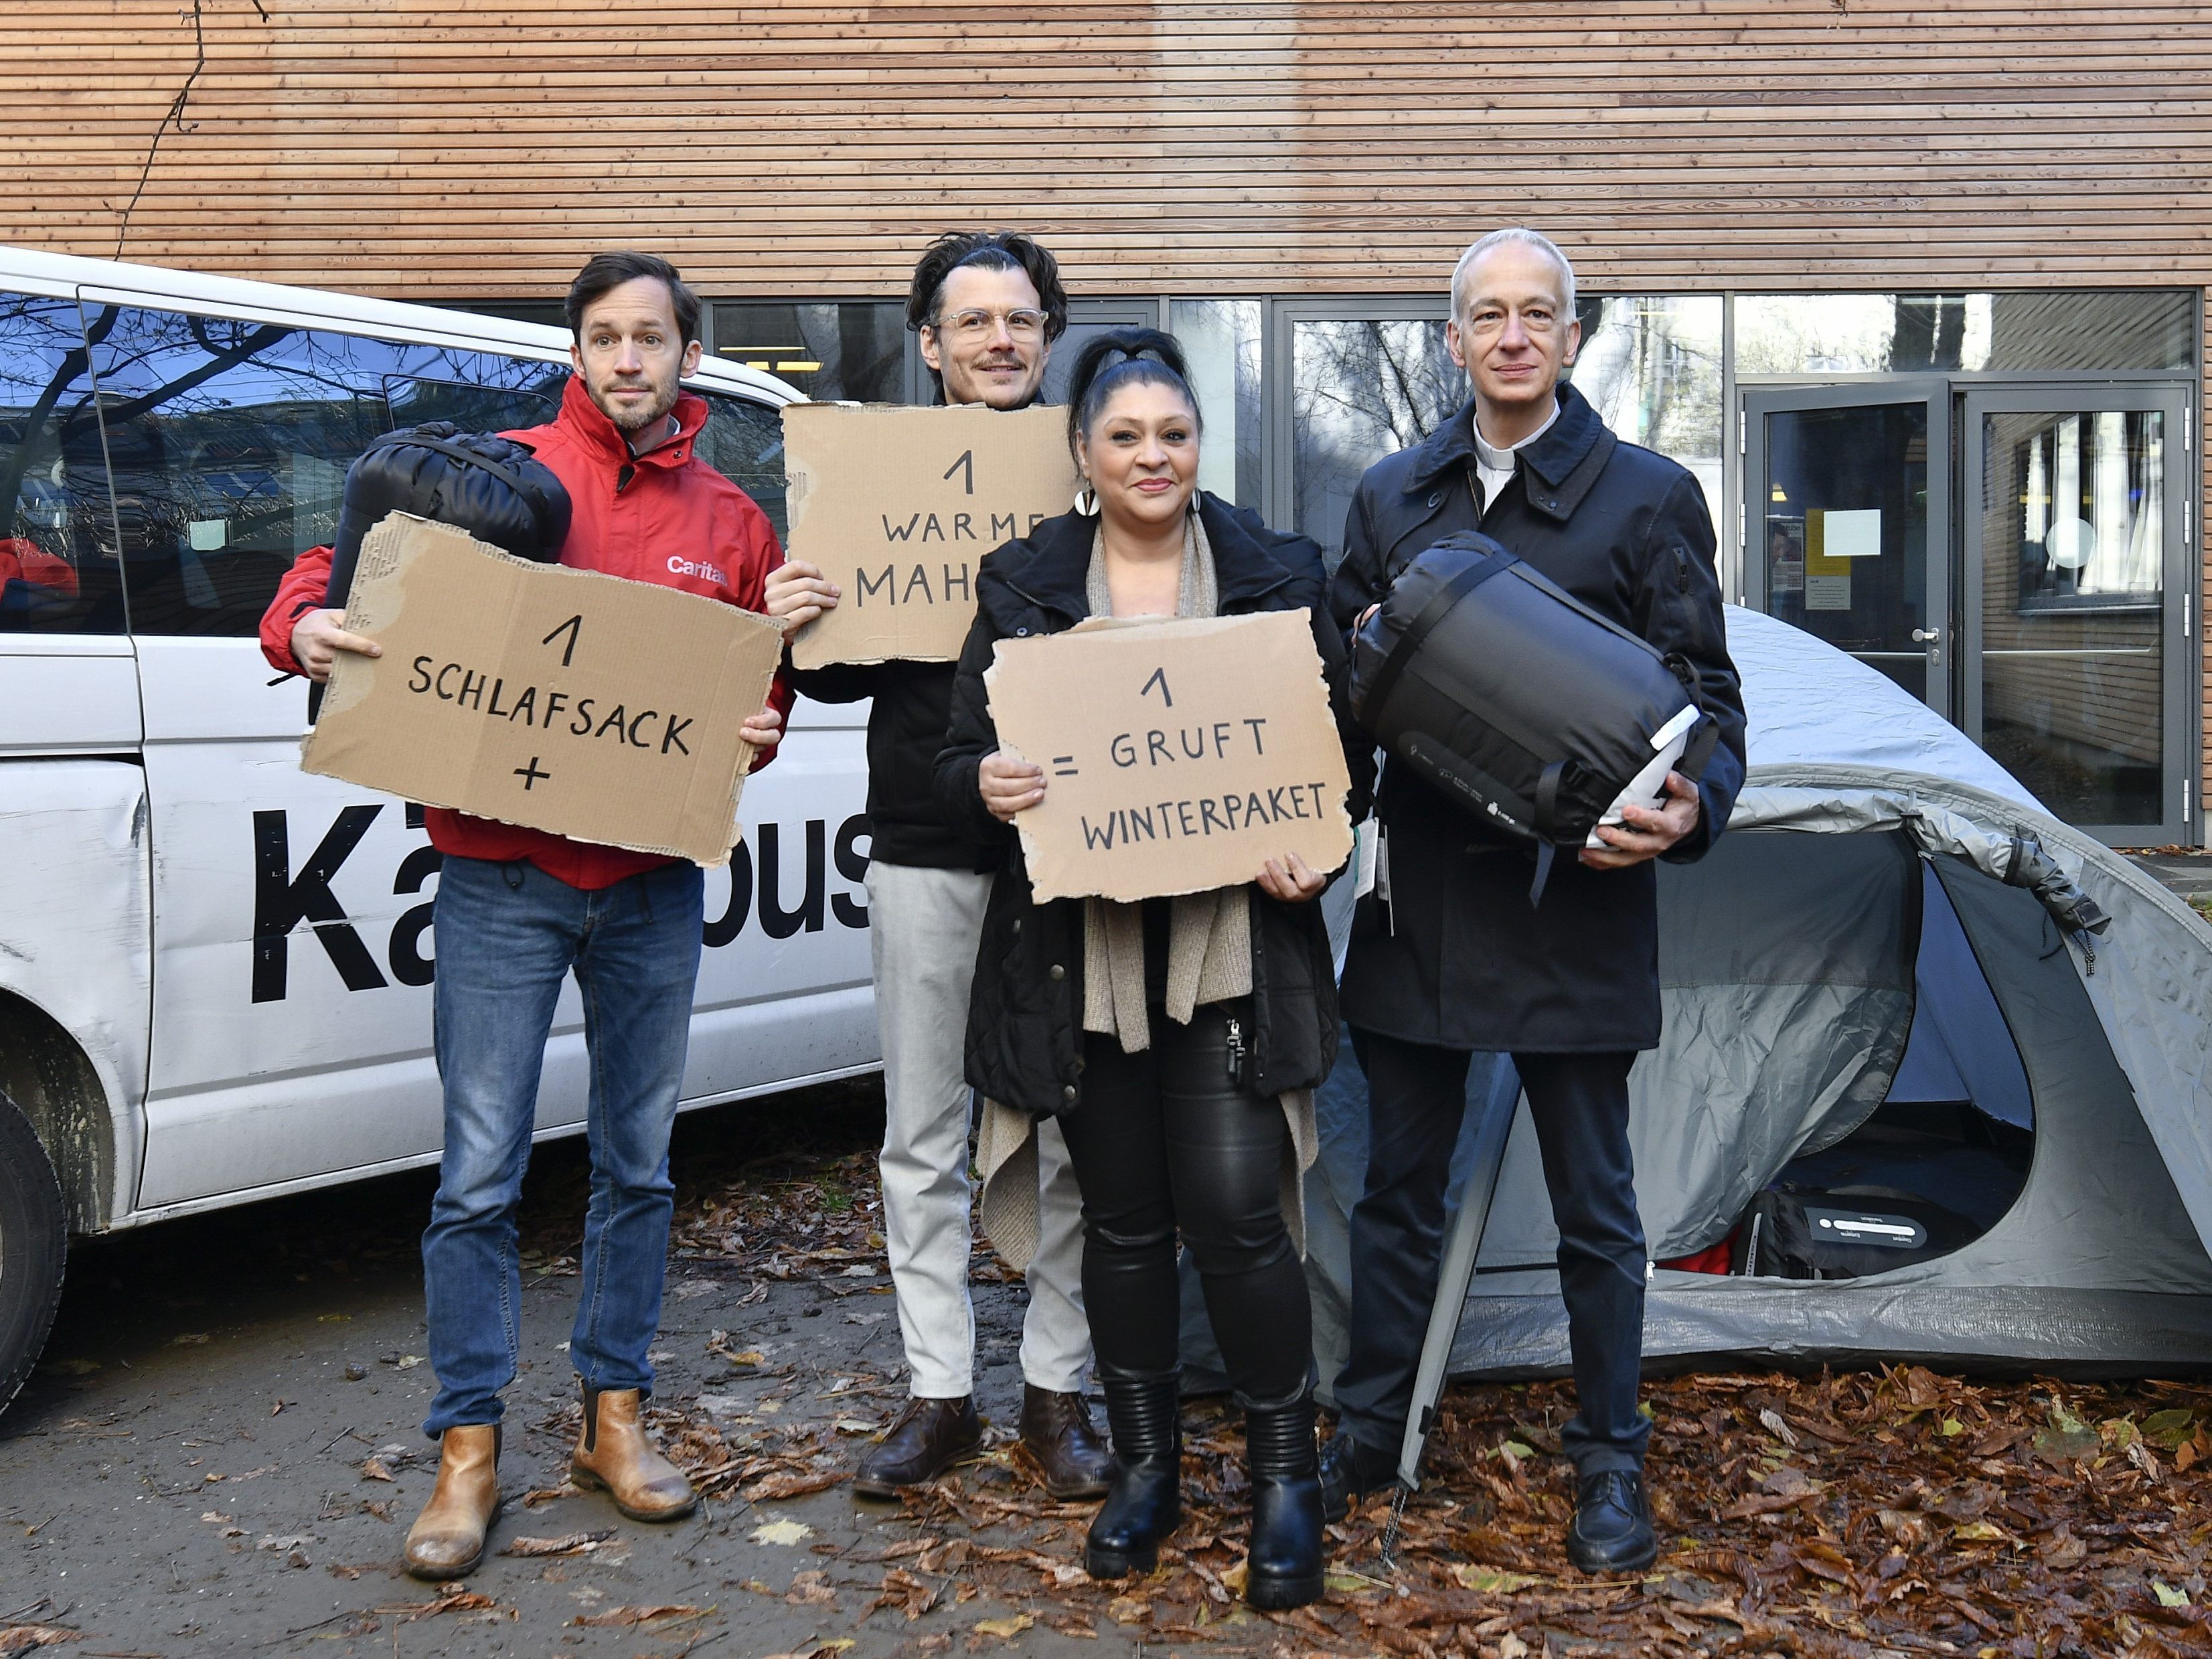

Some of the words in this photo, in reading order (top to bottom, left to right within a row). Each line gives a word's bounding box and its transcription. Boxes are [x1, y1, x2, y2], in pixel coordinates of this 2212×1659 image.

[943, 449, 974, 495] 1
[542, 614, 582, 667] 1
[408, 655, 694, 756] SCHLAFSACK
[1140, 667, 1173, 708] 1
[1110, 718, 1267, 768] GRUFT
[512, 756, 551, 791] +
[1081, 781, 1326, 850] WINTERPAKET
